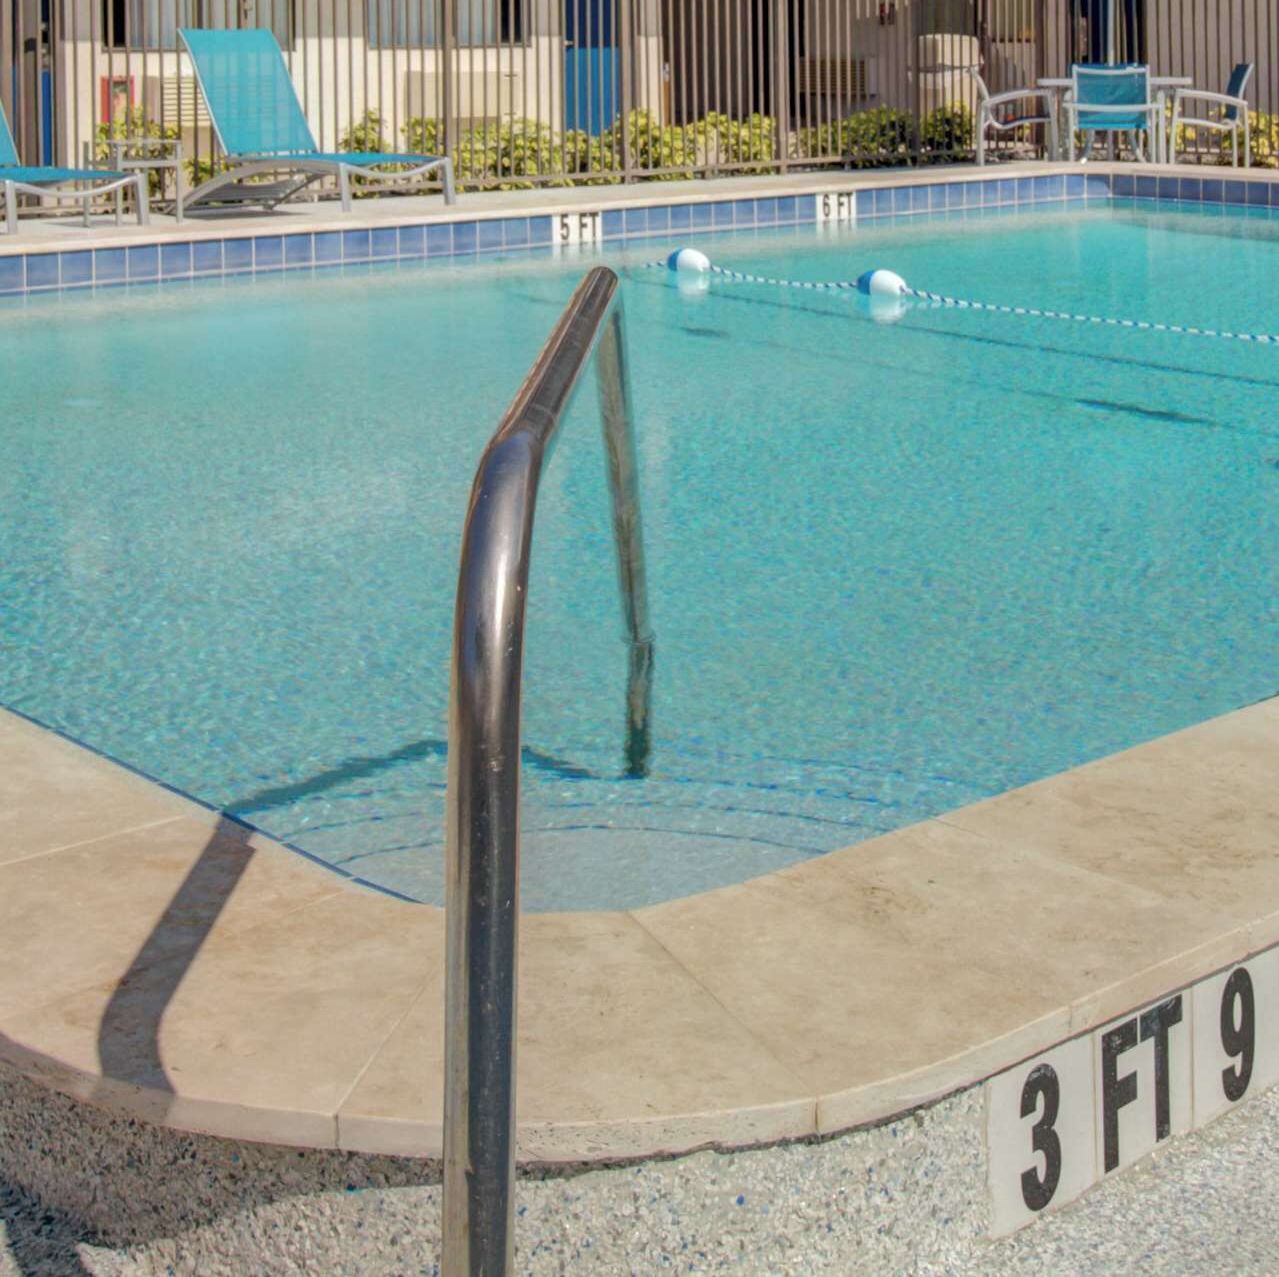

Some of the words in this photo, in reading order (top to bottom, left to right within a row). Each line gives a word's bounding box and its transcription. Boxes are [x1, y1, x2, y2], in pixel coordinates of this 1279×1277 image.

[823, 193, 830, 217] 6
[837, 192, 853, 217] FT
[560, 213, 569, 240] 5
[579, 212, 599, 240] FT
[1020, 1063, 1061, 1212] 3
[1102, 994, 1183, 1175] FT
[1220, 967, 1255, 1102] 9
